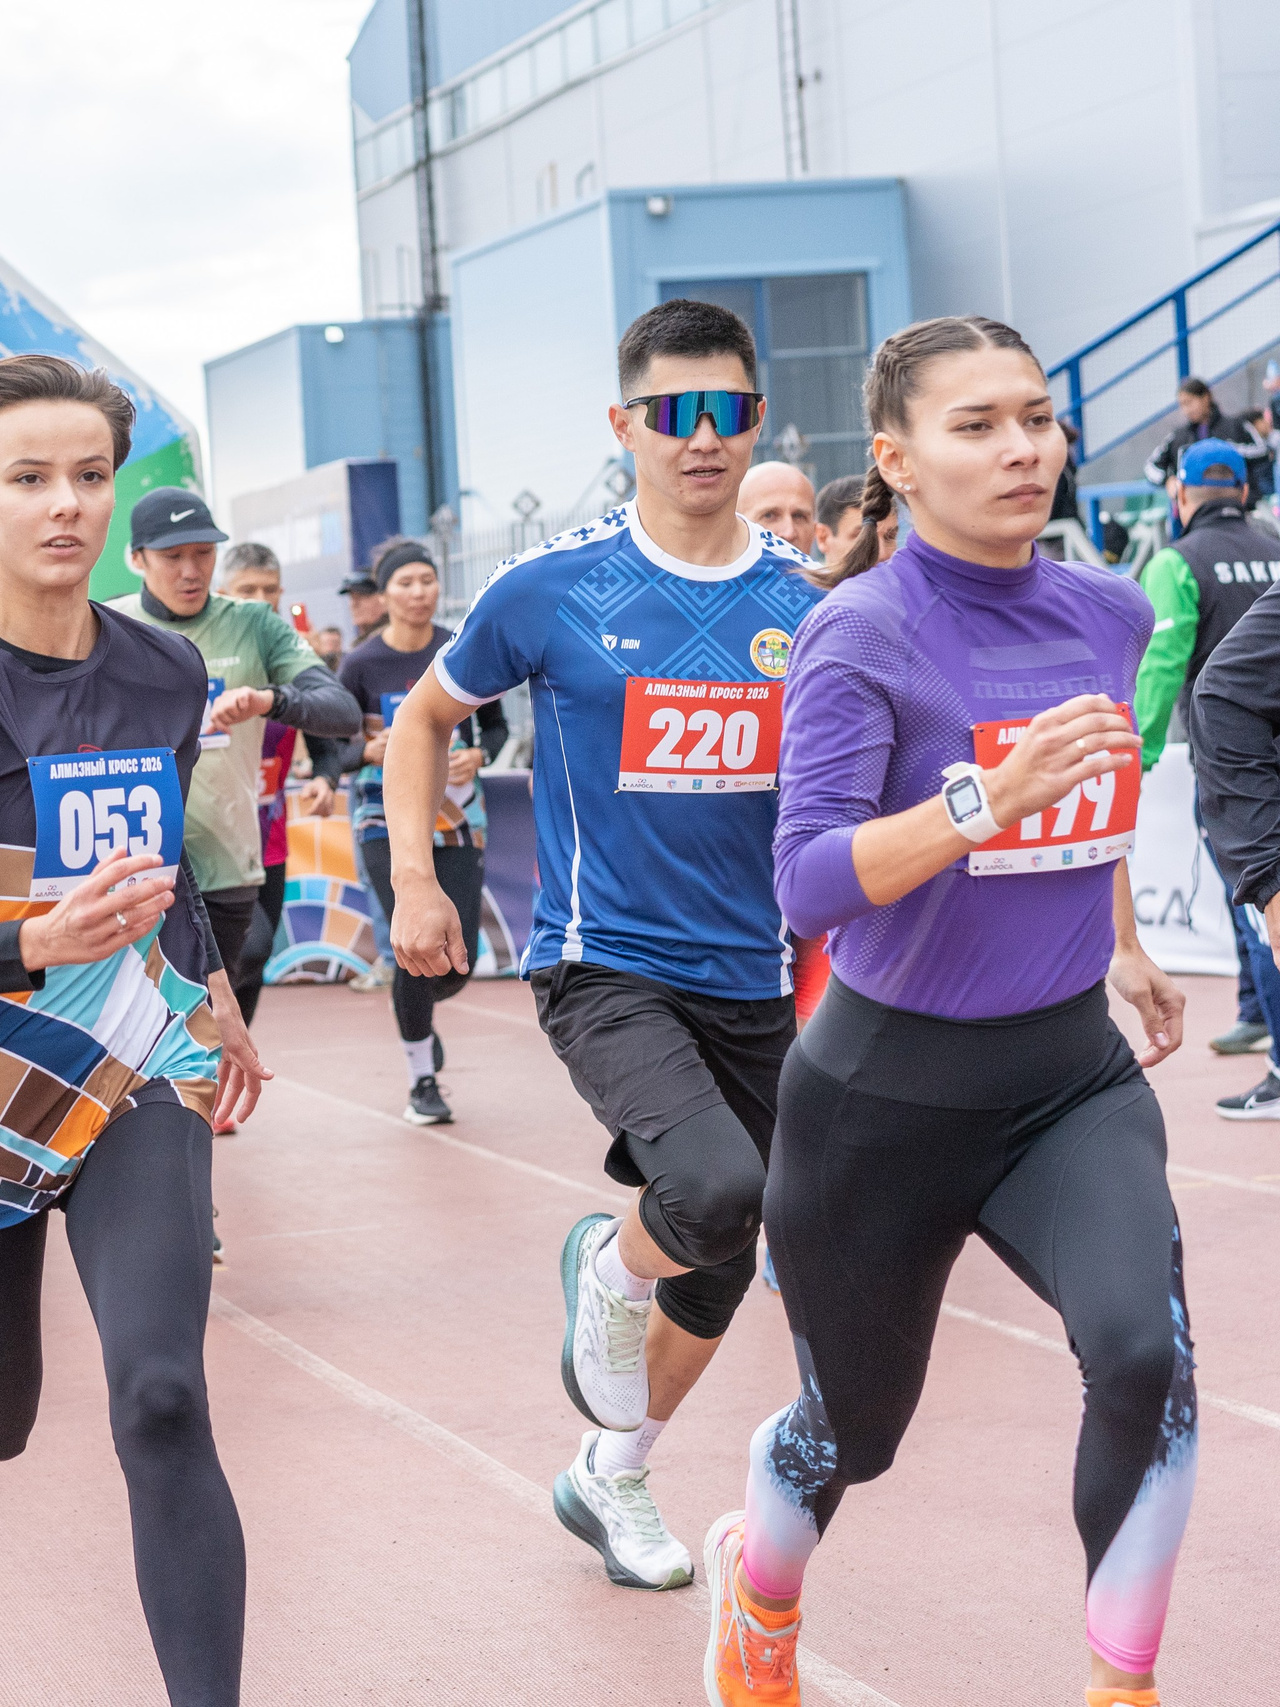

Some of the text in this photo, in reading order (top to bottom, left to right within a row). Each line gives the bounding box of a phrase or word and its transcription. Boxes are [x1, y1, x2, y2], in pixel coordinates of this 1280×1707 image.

[621, 638, 641, 650] IRON
[645, 683, 769, 700] АЛМАЗНЫЙ КРОСС 2026
[646, 708, 759, 770] 220
[50, 757, 162, 779] АЛМАЗНЫЙ КРОСС 2026
[59, 785, 163, 869] 053
